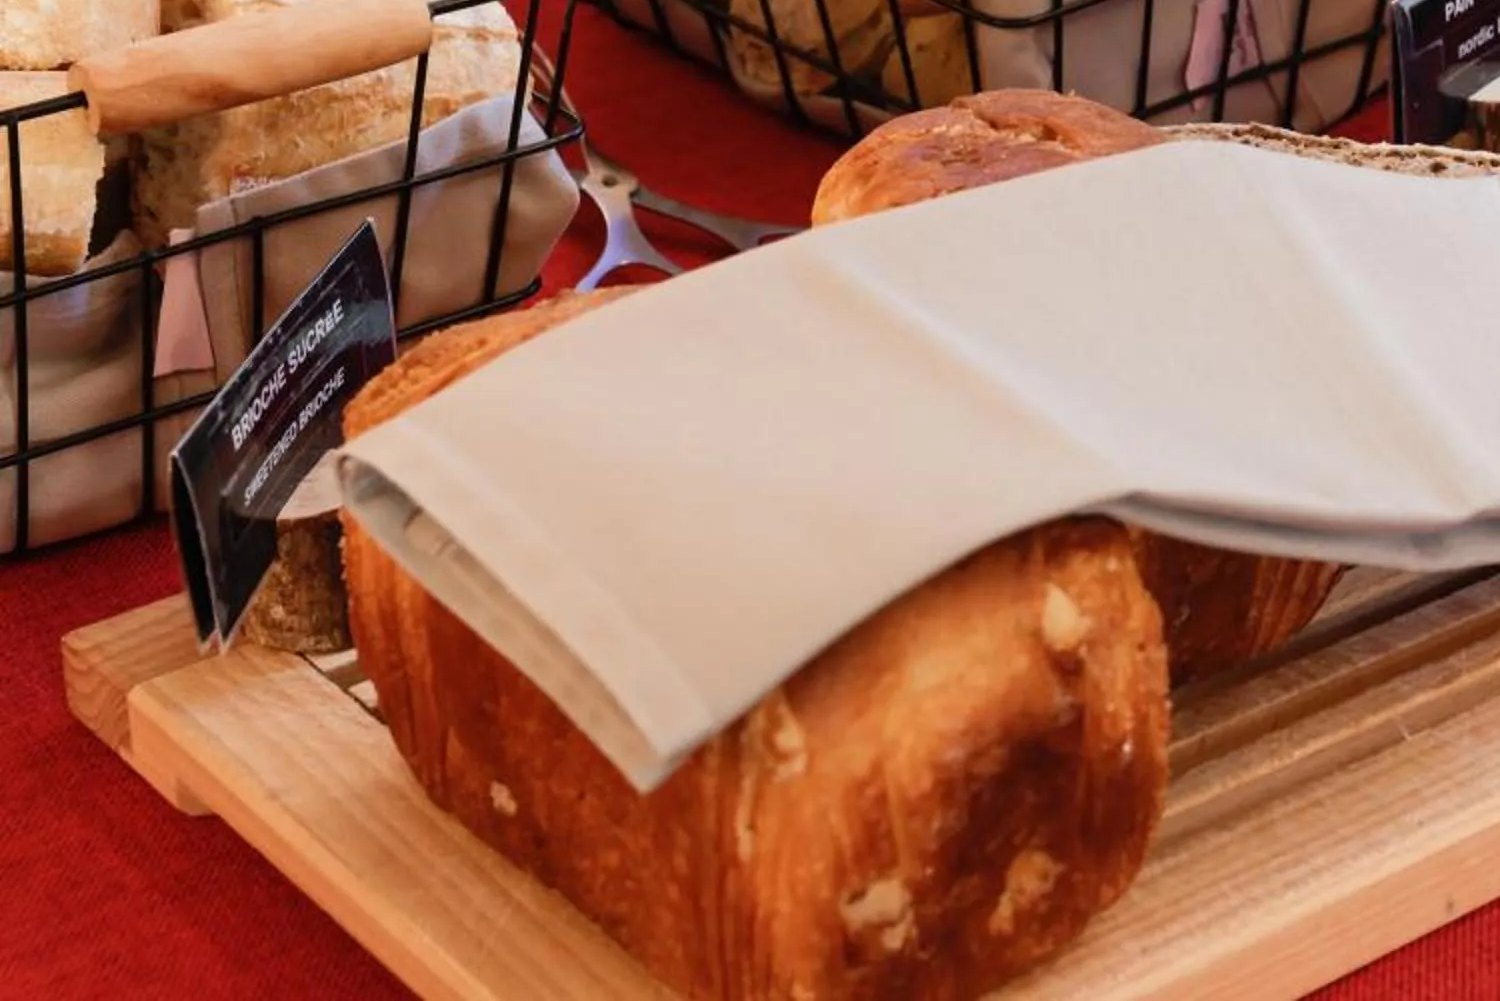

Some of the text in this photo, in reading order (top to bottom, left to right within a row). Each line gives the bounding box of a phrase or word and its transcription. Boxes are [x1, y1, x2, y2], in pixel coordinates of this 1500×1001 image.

[1457, 23, 1494, 60] nordic
[231, 363, 287, 450] BRIOCHE
[244, 366, 345, 507] SWEETENED BRIOCHE
